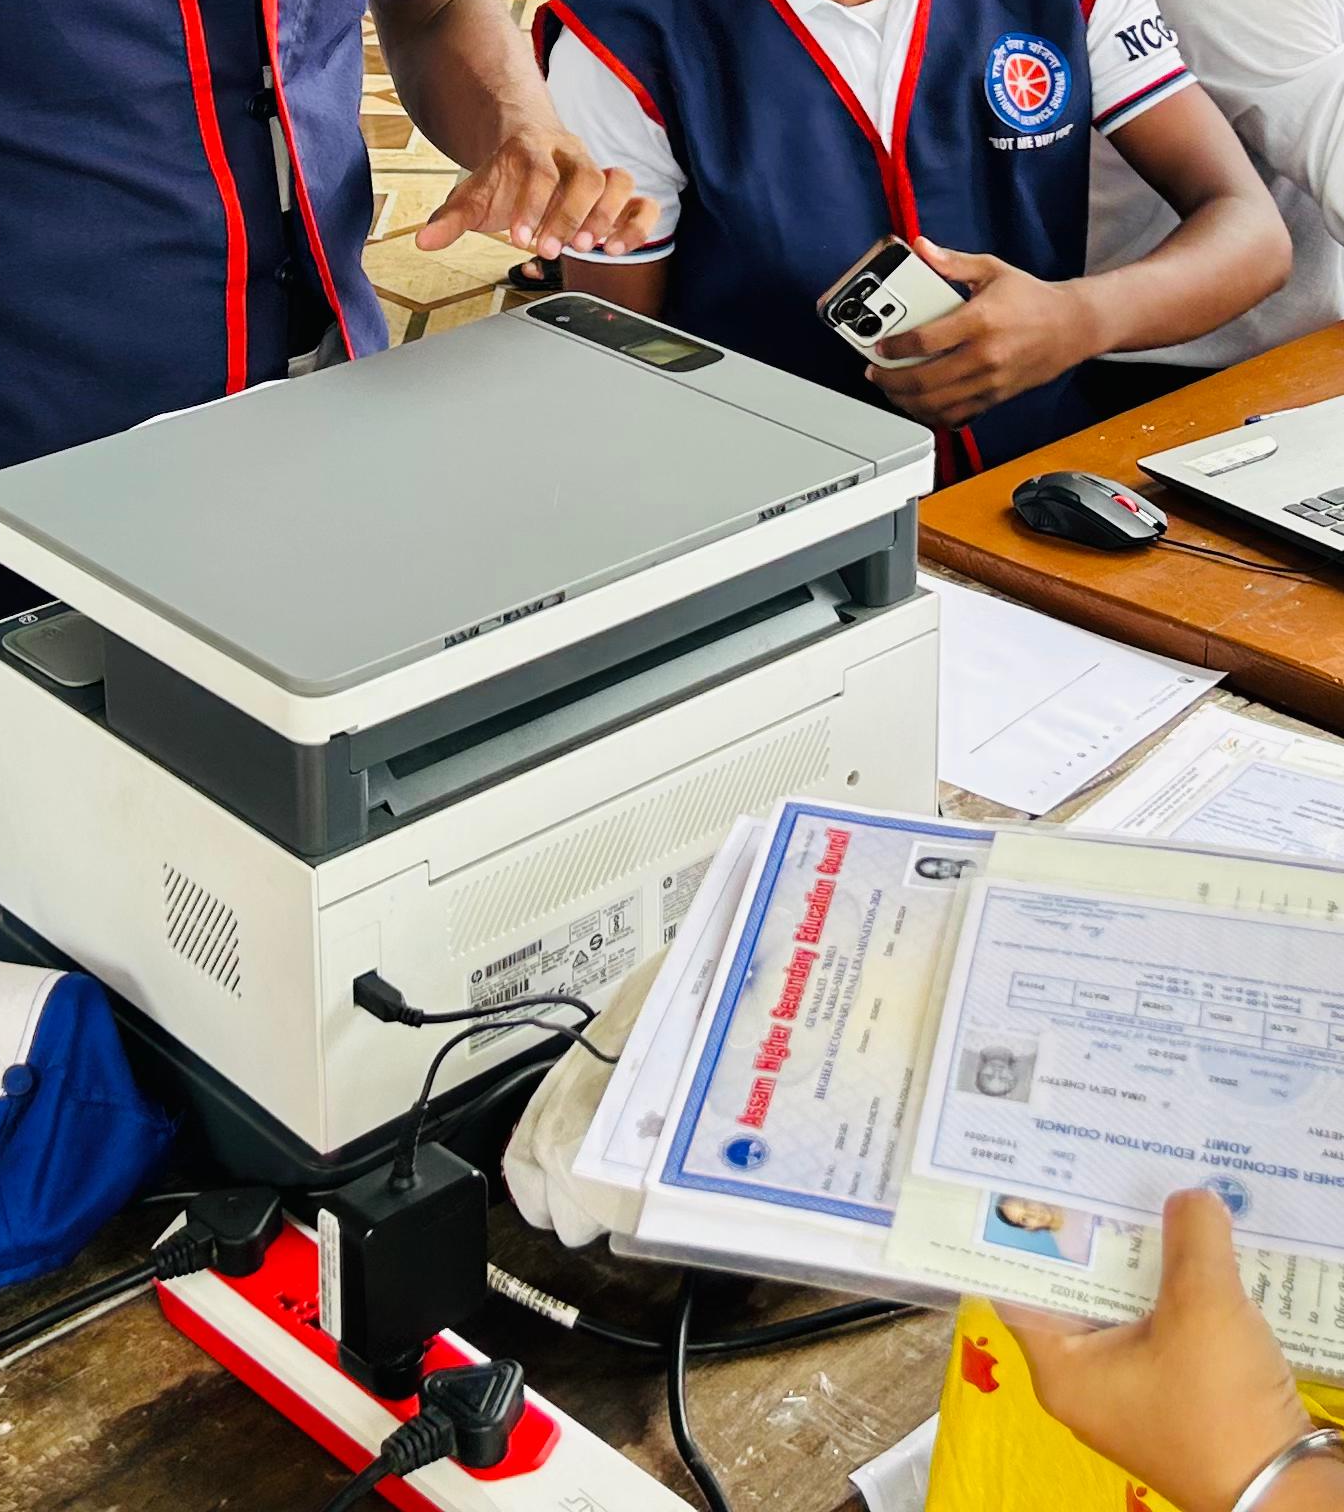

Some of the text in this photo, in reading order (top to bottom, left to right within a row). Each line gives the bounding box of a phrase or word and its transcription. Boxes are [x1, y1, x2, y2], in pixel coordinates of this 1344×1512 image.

[811, 827, 852, 876] Council
[791, 876, 838, 945] Education
[768, 945, 821, 1022] Secondary
[753, 1022, 797, 1074] Higher
[735, 1074, 778, 1129] Assam
[1029, 1116, 1101, 1141] COUNCIL
[1104, 1131, 1195, 1160] EDUCATION
[1202, 1136, 1251, 1155] ADMIT
[1199, 1151, 1299, 1180] SECONDARY
[1249, 1270, 1272, 1305] illage
